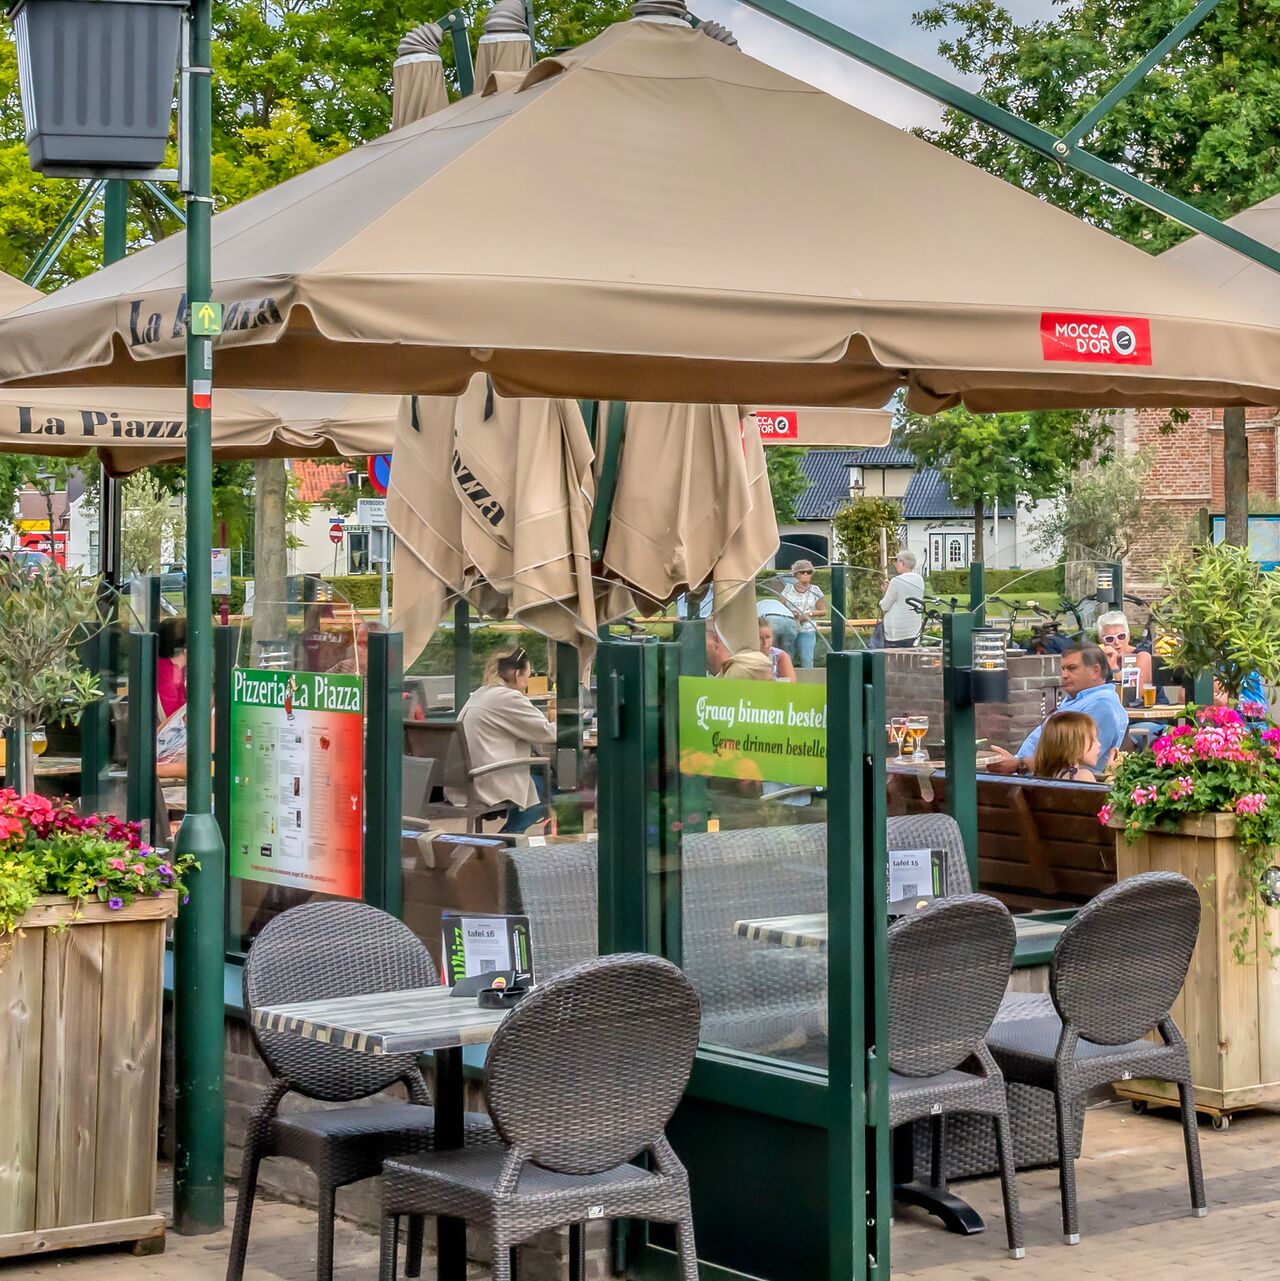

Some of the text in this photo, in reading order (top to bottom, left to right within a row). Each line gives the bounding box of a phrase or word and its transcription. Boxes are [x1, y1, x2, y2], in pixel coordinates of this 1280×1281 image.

[129, 299, 161, 348] La
[1055, 322, 1109, 339] MOCCA
[1076, 338, 1111, 354] D'OR
[16, 406, 187, 439] La Piazz
[234, 671, 285, 706] Pizzeria
[314, 675, 360, 711] Piazza
[696, 695, 735, 731] Graag
[738, 699, 784, 726] binnen
[712, 731, 741, 757] Gerne
[743, 733, 783, 755] drinnen
[892, 859, 910, 867] tafel
[467, 929, 495, 938] tafel 16
